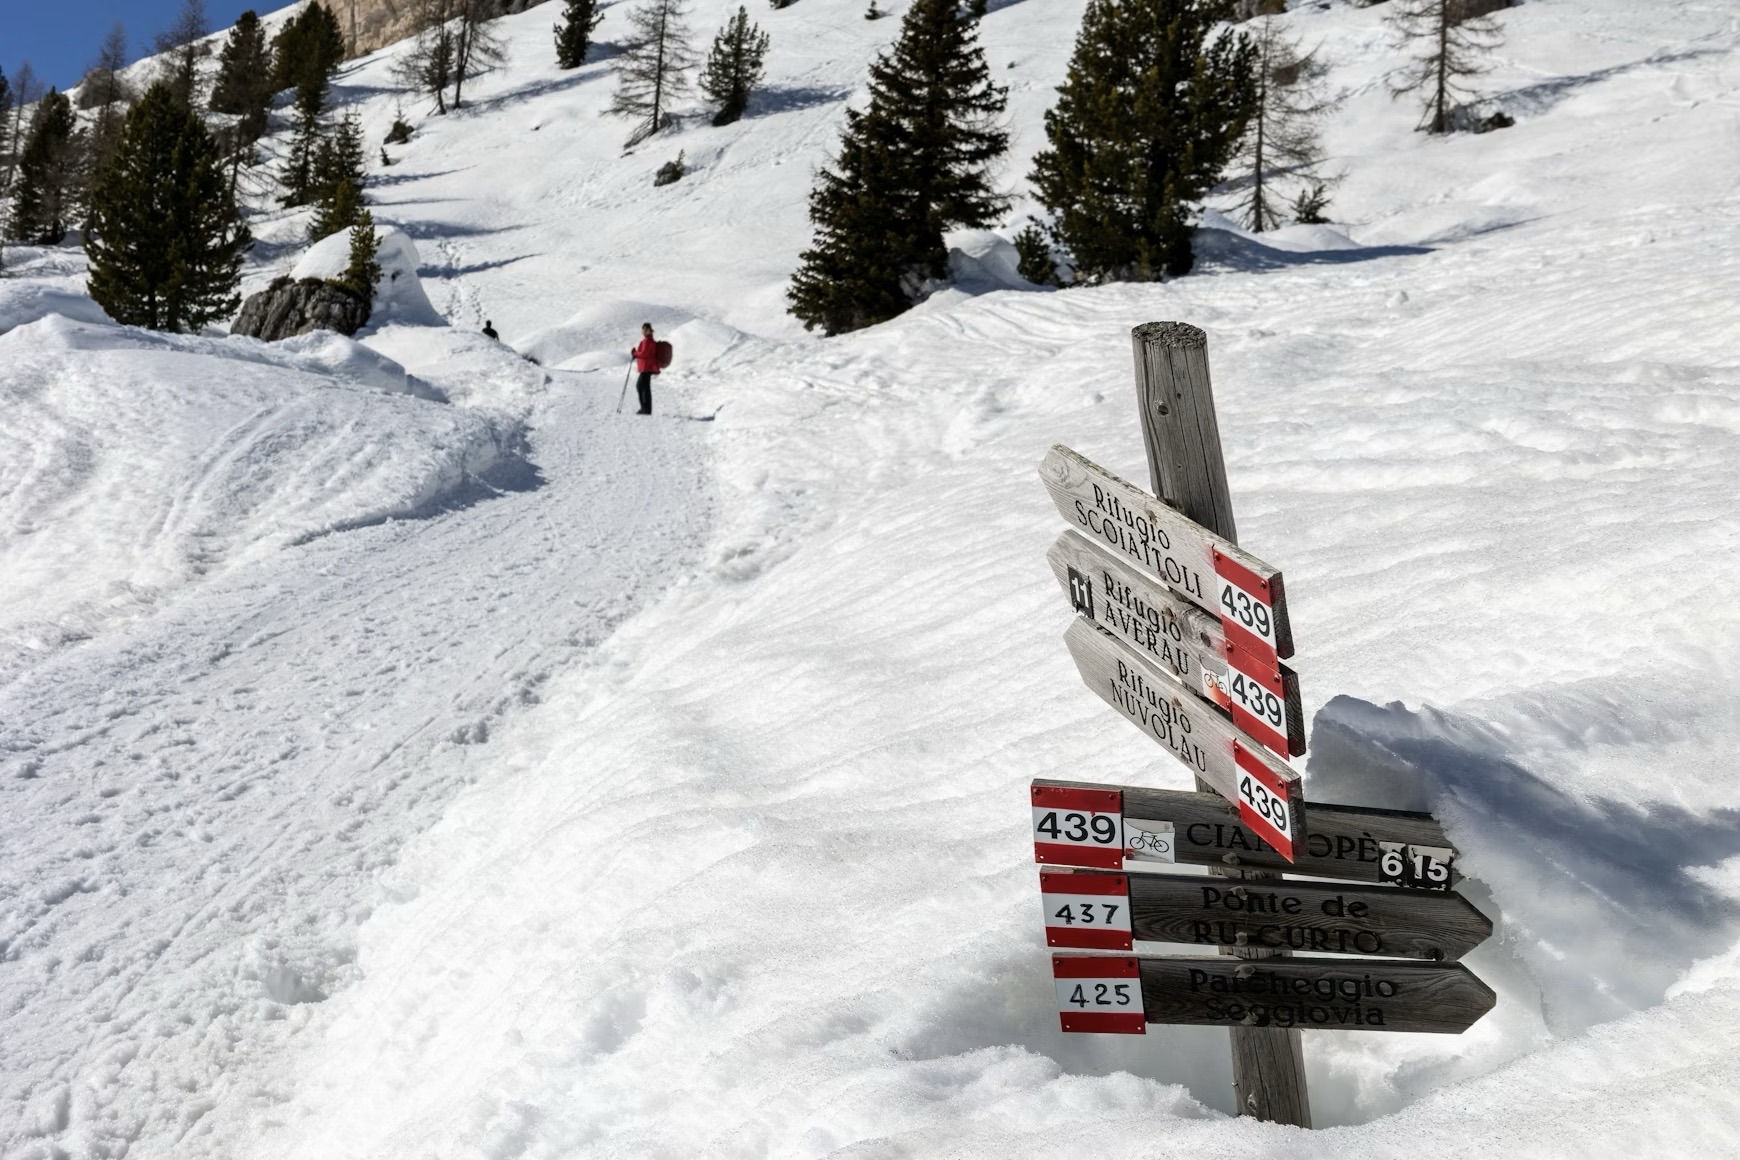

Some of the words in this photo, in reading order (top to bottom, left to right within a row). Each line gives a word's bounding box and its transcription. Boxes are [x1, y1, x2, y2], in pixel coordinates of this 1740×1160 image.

[1092, 483, 1170, 549] Rifugio
[1075, 500, 1203, 599] SCOIATTOLI
[1103, 571, 1181, 642] Rifugio
[1221, 584, 1270, 638] 439
[1105, 600, 1188, 674] AVERAU
[1117, 659, 1191, 734] Rifugio
[1232, 673, 1281, 727] 439
[1110, 679, 1206, 772] NUVOLAU
[1037, 811, 1116, 844] 439
[1240, 776, 1287, 831] 439
[1187, 823, 1377, 863] CIAOPÈ
[1055, 903, 1119, 925] 437
[1201, 886, 1302, 915] Ponte
[1322, 895, 1368, 918] de
[1192, 920, 1241, 945] RU
[1257, 925, 1382, 953] CURTO
[1069, 983, 1130, 1008] 425
[1188, 968, 1398, 1002] Parcheggio
[1205, 998, 1386, 1027] Seggiovia
